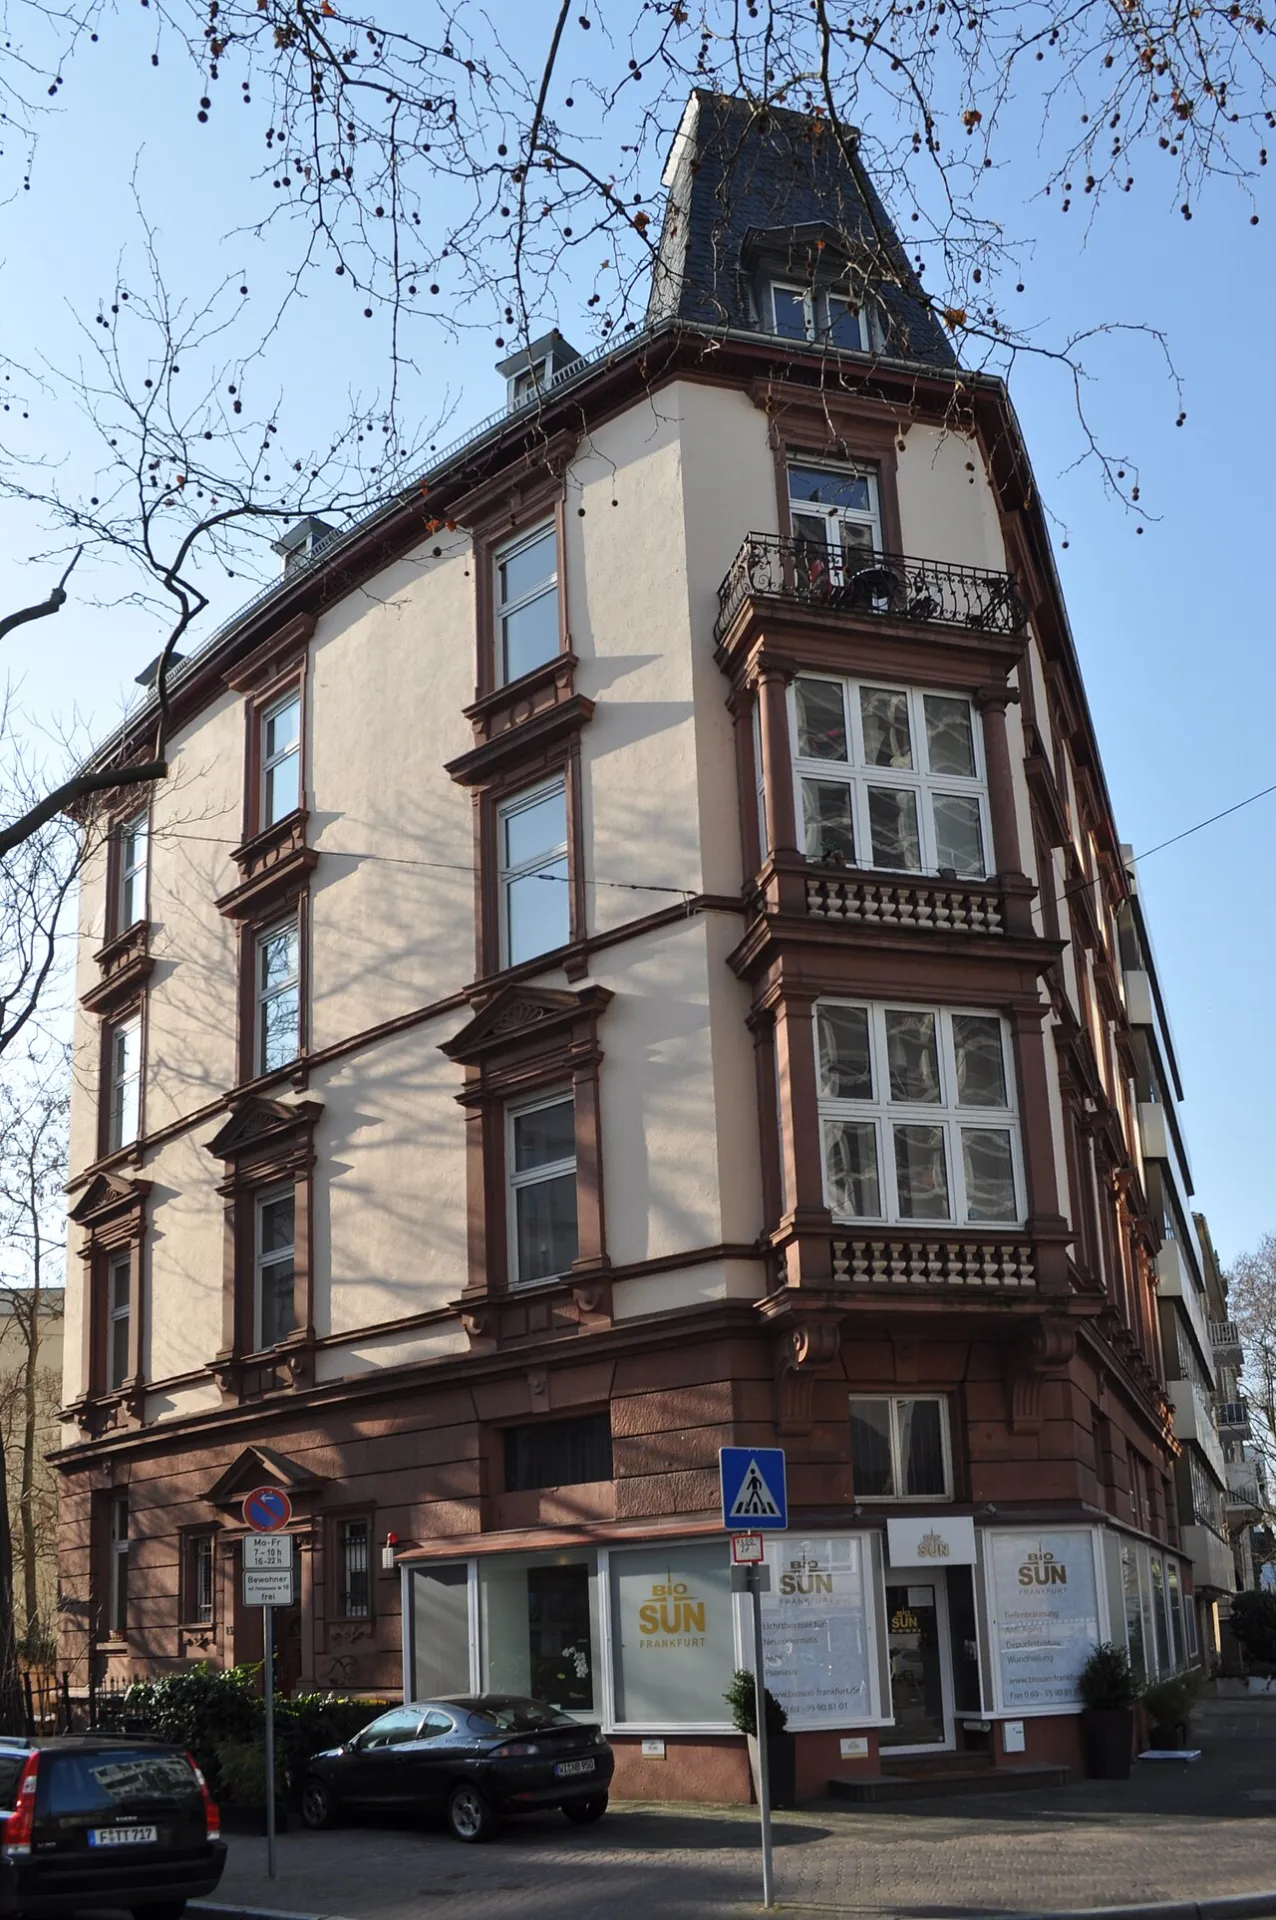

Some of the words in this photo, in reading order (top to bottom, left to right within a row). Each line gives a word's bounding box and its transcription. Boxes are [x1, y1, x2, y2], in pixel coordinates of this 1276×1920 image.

[254, 1538, 281, 1546] Mo-Fr
[918, 1543, 949, 1557] SUN
[1027, 1552, 1054, 1561] BIO
[790, 1560, 818, 1569] BIO
[247, 1575, 288, 1584] Bewohner
[1018, 1564, 1067, 1586] SUN
[652, 1583, 688, 1596] BIO
[781, 1573, 833, 1595] SUN
[261, 1592, 276, 1601] frei
[639, 1601, 707, 1635] SUN
[891, 1615, 918, 1629] SUN
[639, 1637, 706, 1649] FRANKFURT
[100, 1829, 108, 1842] F
[115, 1828, 129, 1842] TT
[131, 1827, 153, 1841] 717
